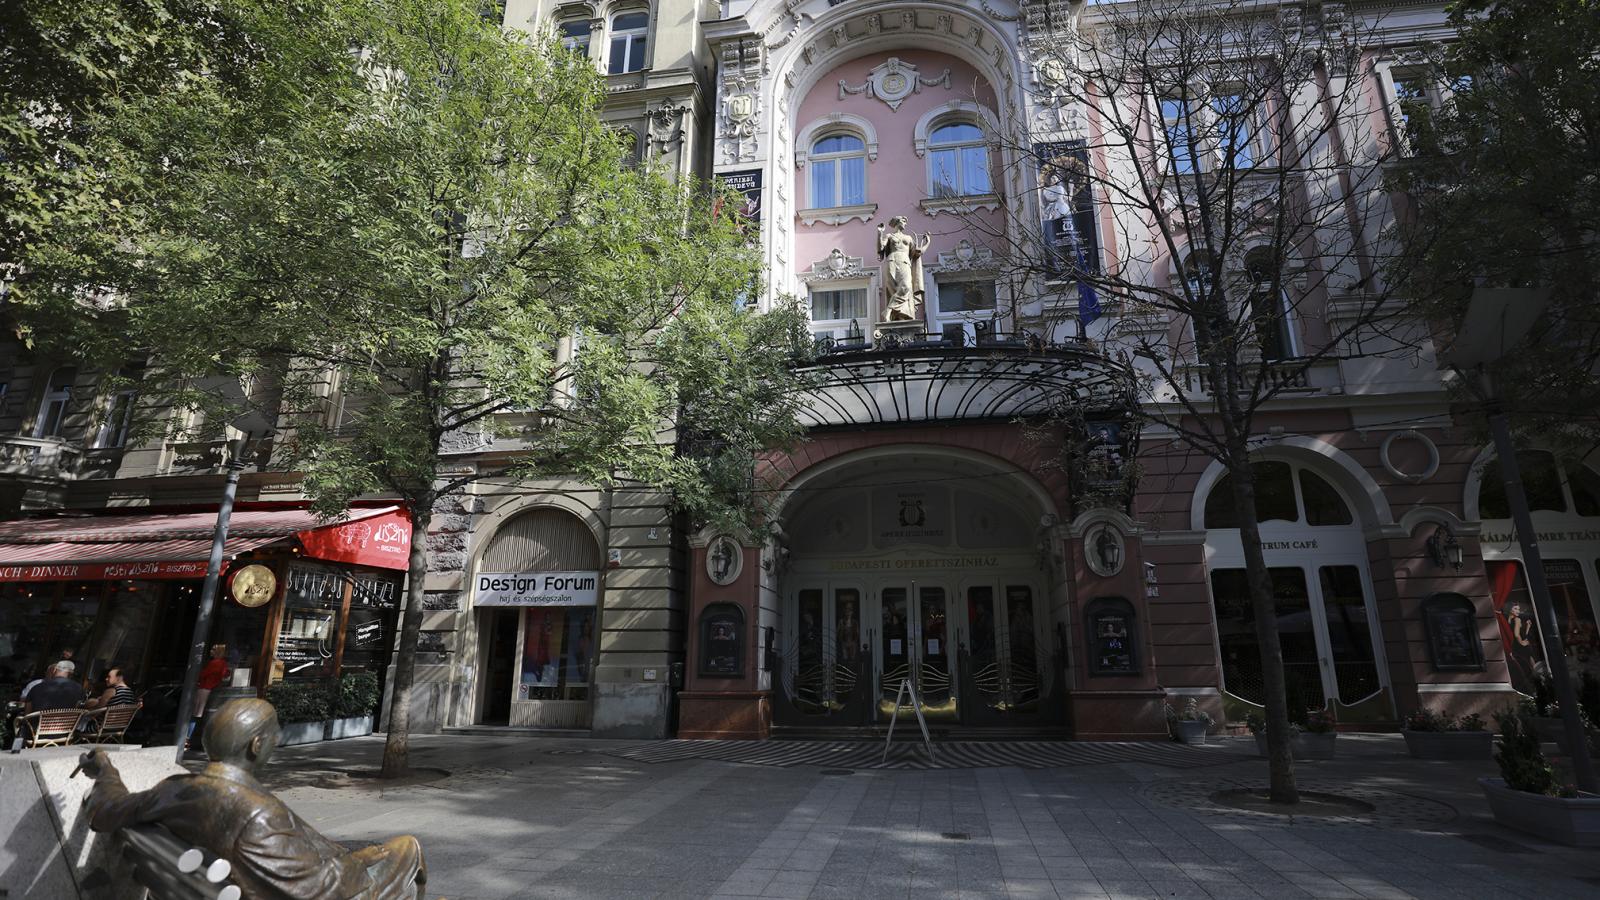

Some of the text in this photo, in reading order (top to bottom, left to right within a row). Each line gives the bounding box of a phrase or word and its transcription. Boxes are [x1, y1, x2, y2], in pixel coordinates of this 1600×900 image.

[1480, 531, 1520, 542] KÁLMÁ
[1538, 532, 1567, 541] MRE
[1261, 538, 1318, 550] TRUM CAFÉ
[831, 560, 890, 570] BUDAPESTI
[31, 566, 79, 577] DINNER
[480, 574, 594, 595] Design Forum
[499, 595, 511, 604] haj
[523, 594, 572, 604] szépségszalon
